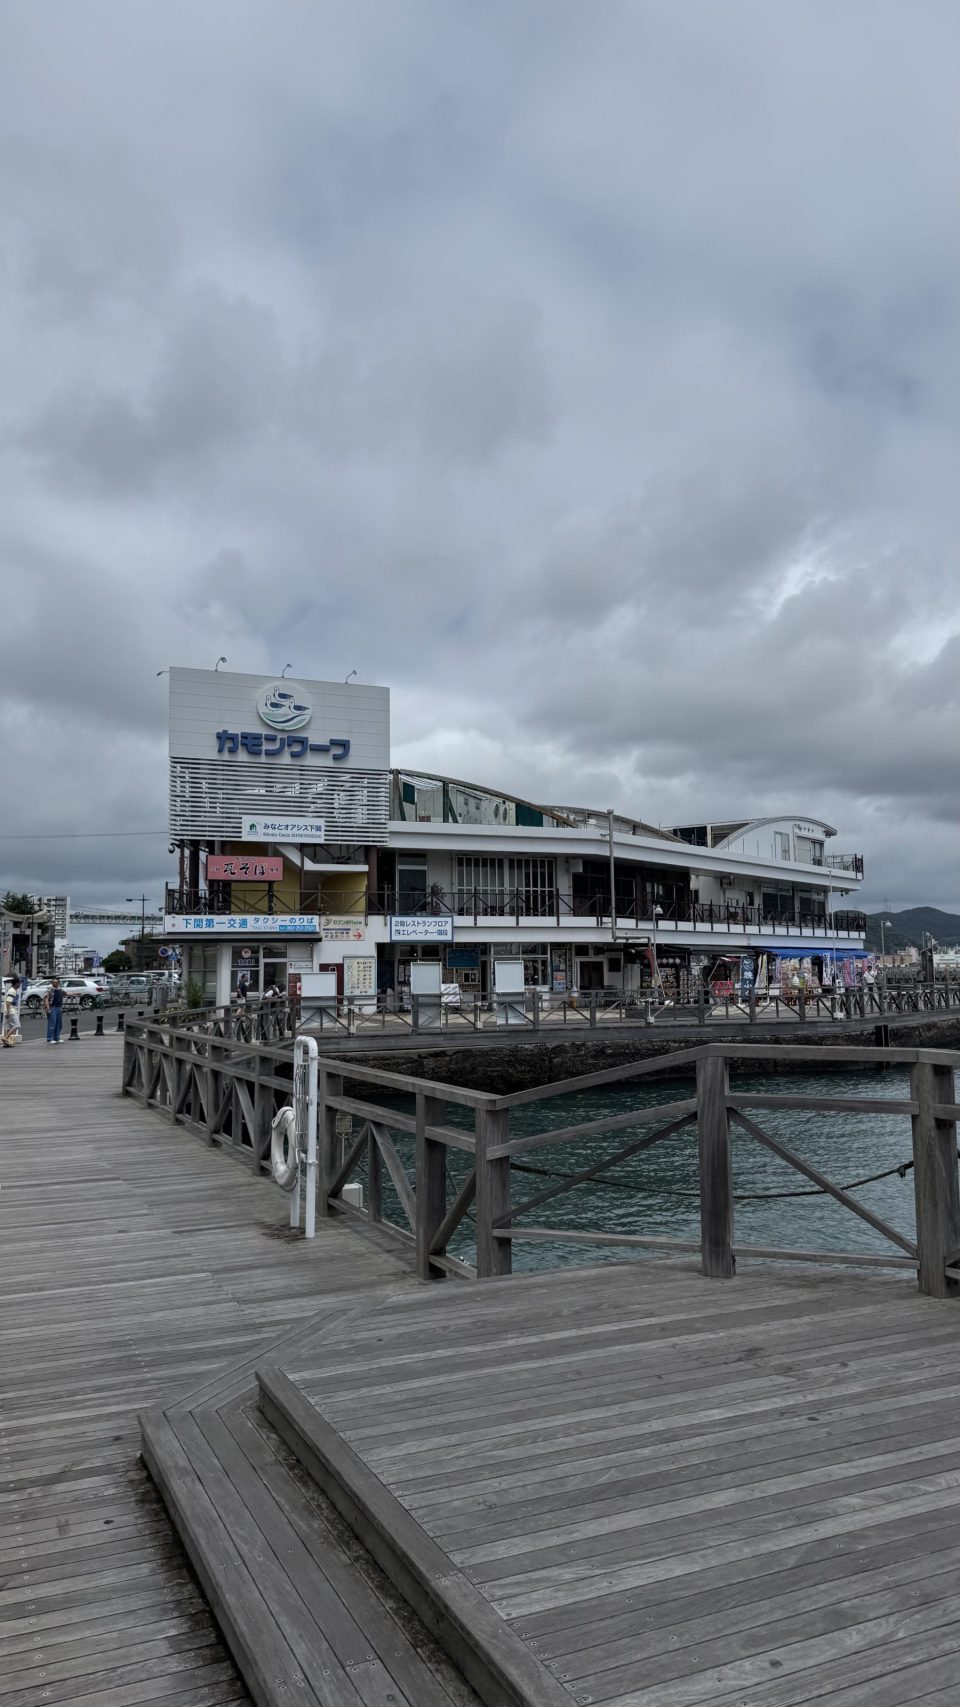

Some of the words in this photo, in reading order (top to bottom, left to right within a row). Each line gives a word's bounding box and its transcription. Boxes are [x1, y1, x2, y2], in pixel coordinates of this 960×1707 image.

[216, 729, 351, 760] カモンワーフ
[263, 823, 322, 832] みなとオアシス下関
[223, 862, 267, 876] 瓦そば
[182, 918, 248, 929] 下関第一交通
